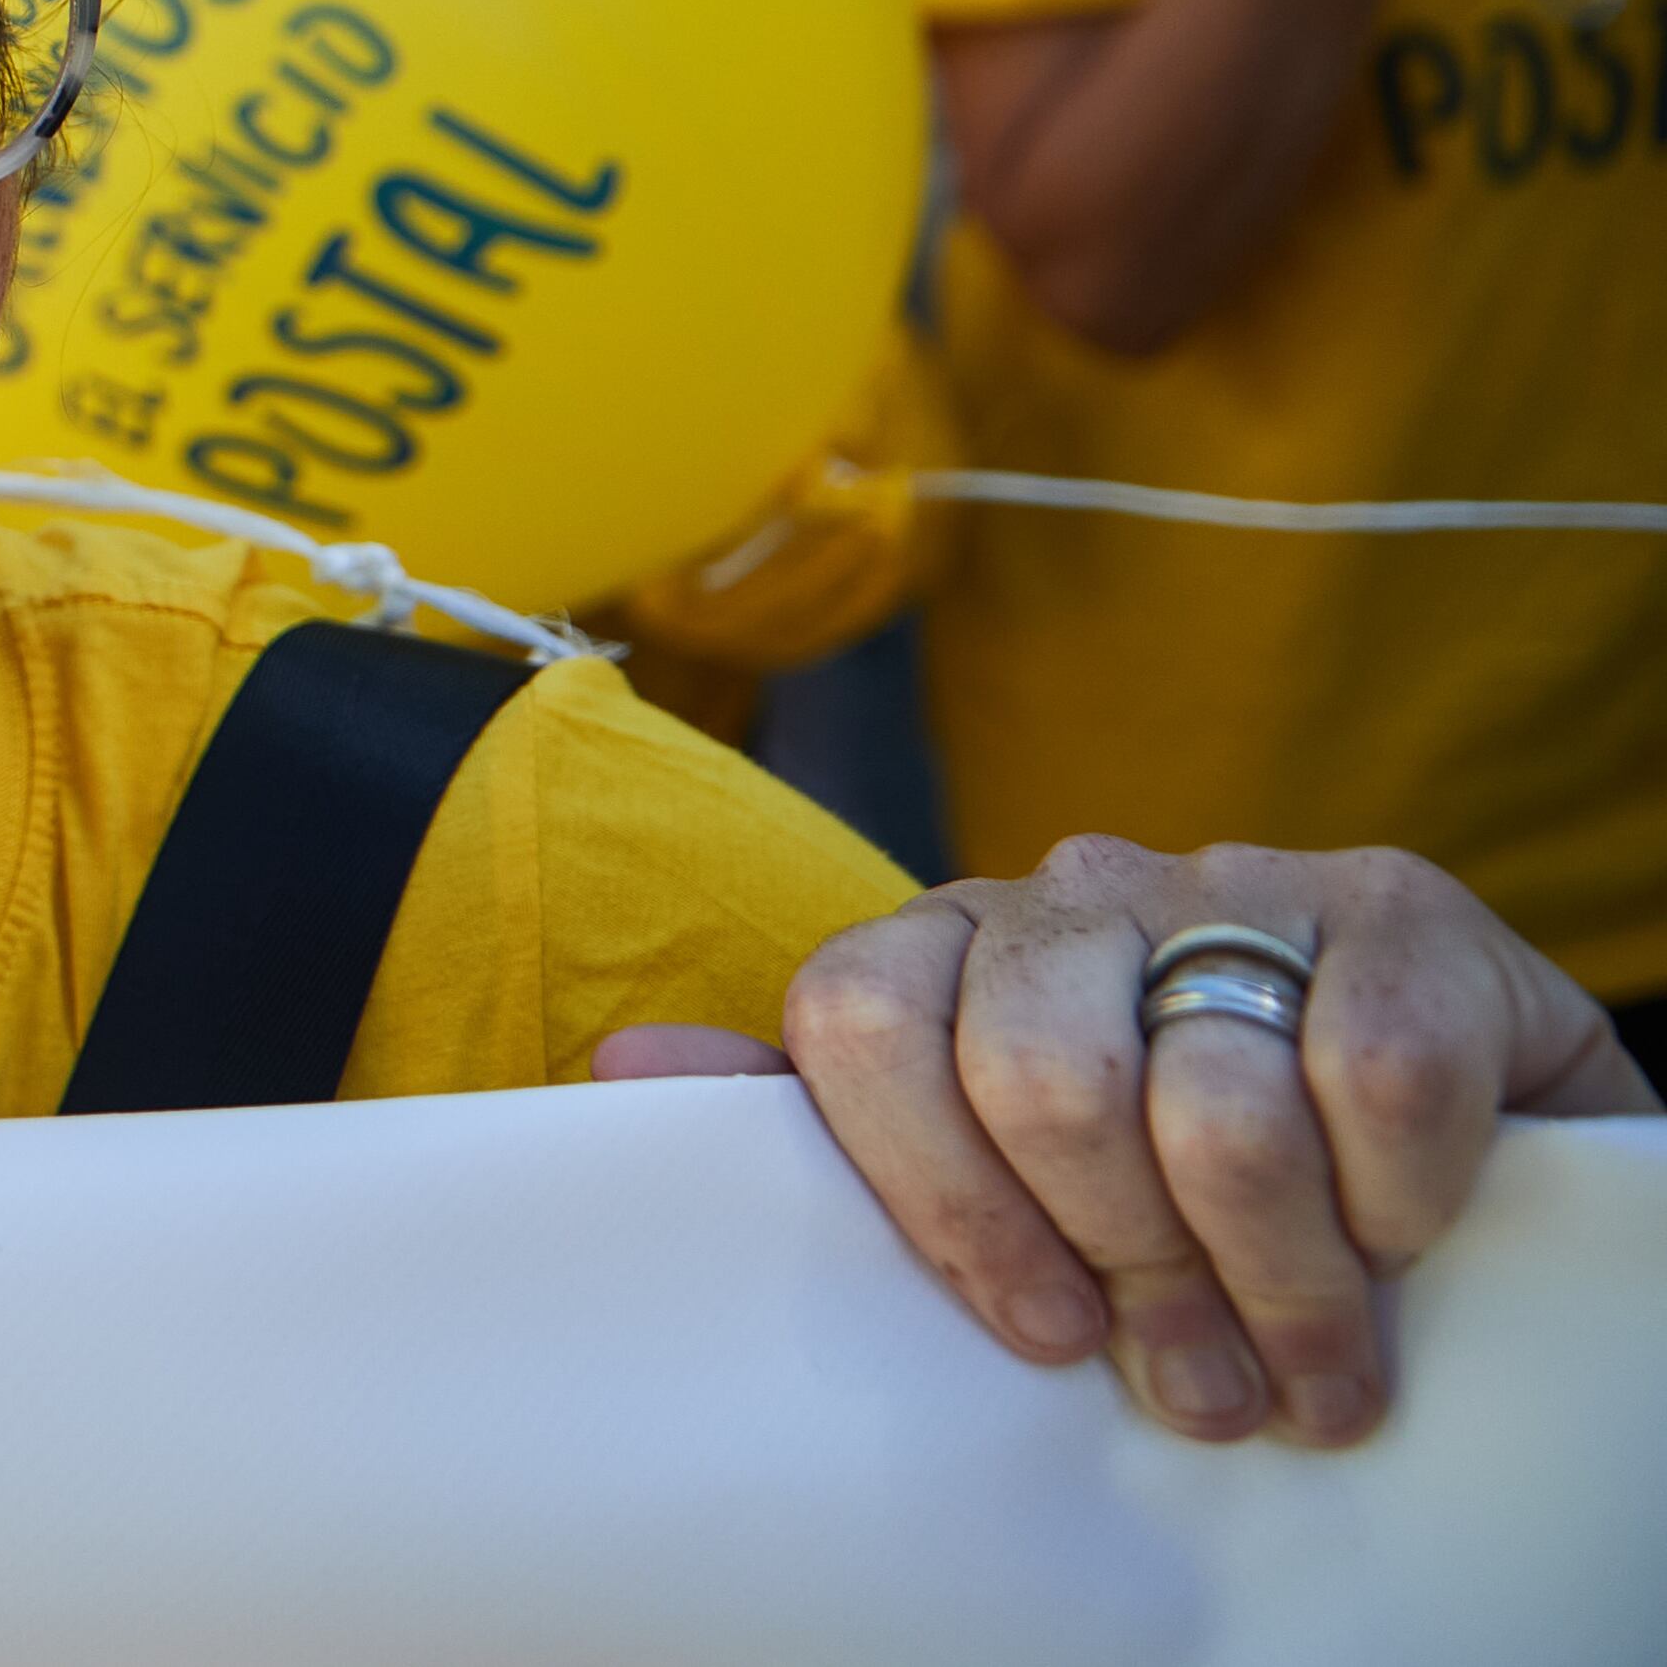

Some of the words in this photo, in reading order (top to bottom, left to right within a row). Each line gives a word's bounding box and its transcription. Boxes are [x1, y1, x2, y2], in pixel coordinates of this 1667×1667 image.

[97, 0, 402, 369] SERVICIO
[181, 102, 629, 532] POSTAL
[61, 374, 169, 448] EL
